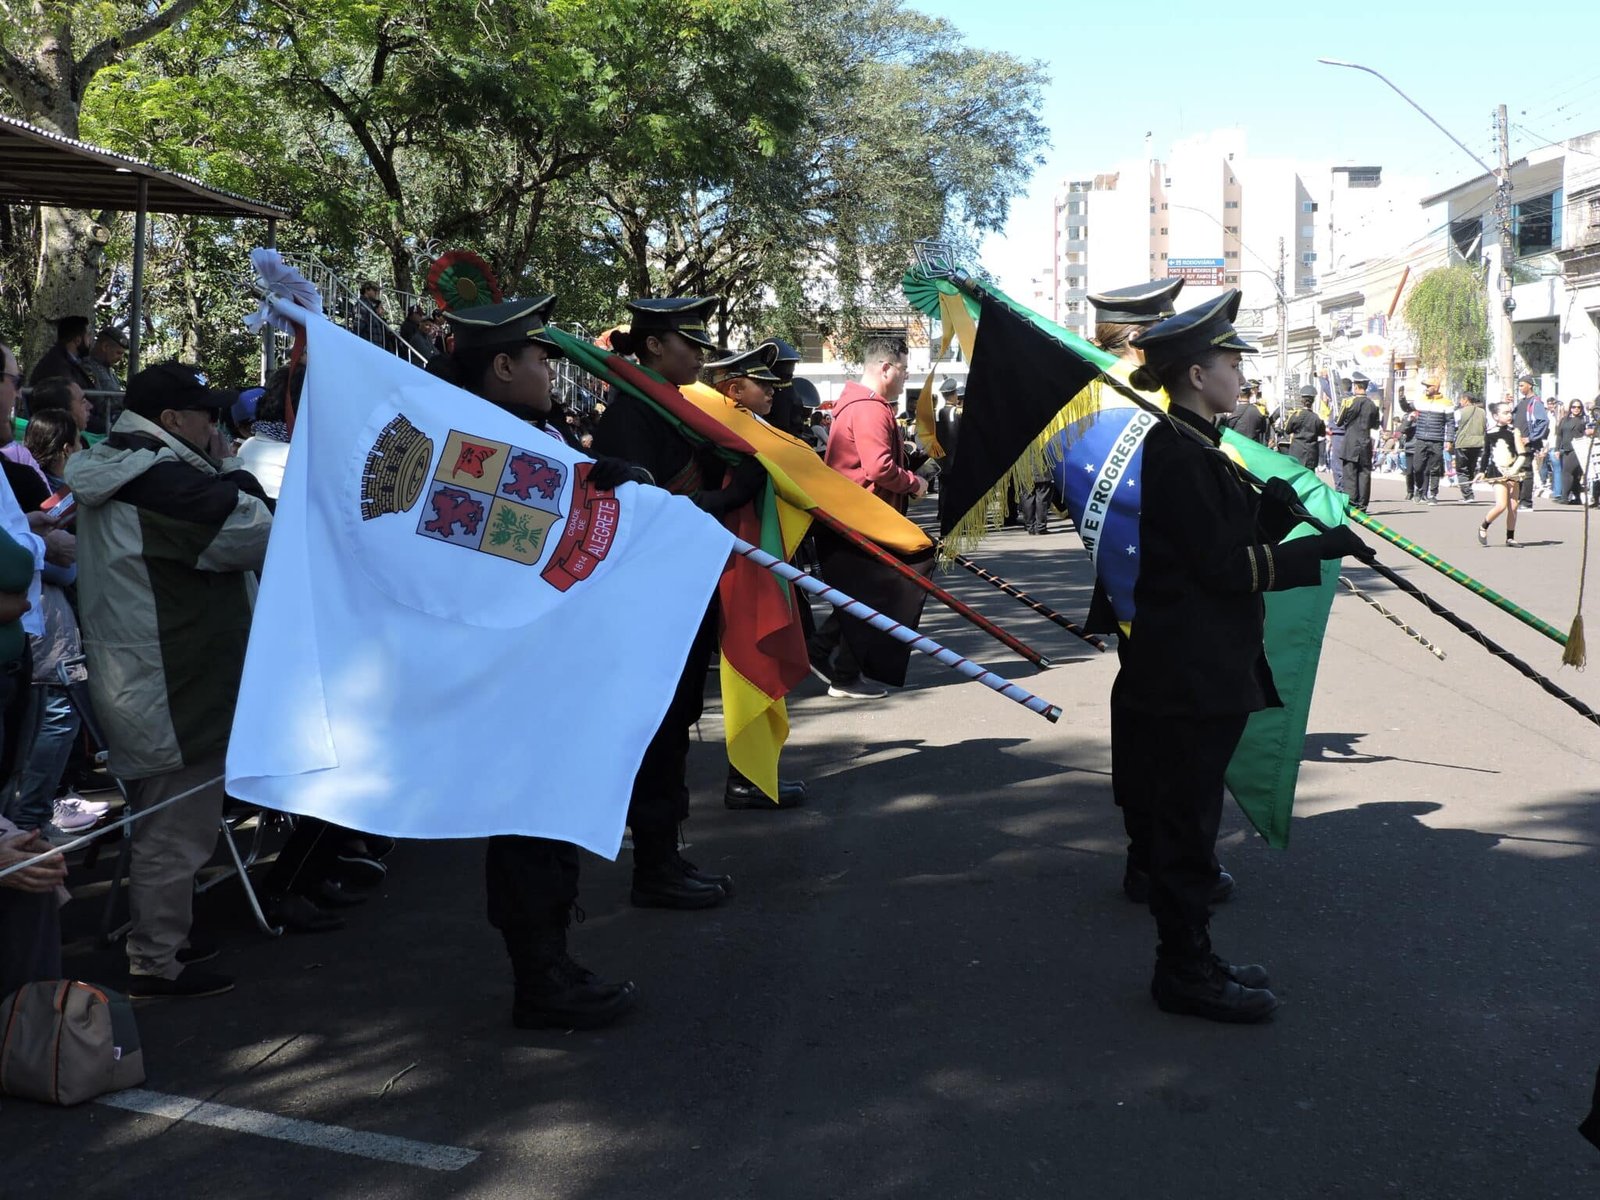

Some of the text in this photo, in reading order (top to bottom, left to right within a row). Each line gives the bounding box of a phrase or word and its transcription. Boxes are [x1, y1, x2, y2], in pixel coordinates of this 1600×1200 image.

[1089, 412, 1151, 514] PROGRESSO
[568, 508, 581, 537] CIDADE
[578, 519, 586, 531] DE
[588, 501, 615, 557] ALEGRETE
[1084, 518, 1099, 531] E
[573, 555, 588, 573] 1814
